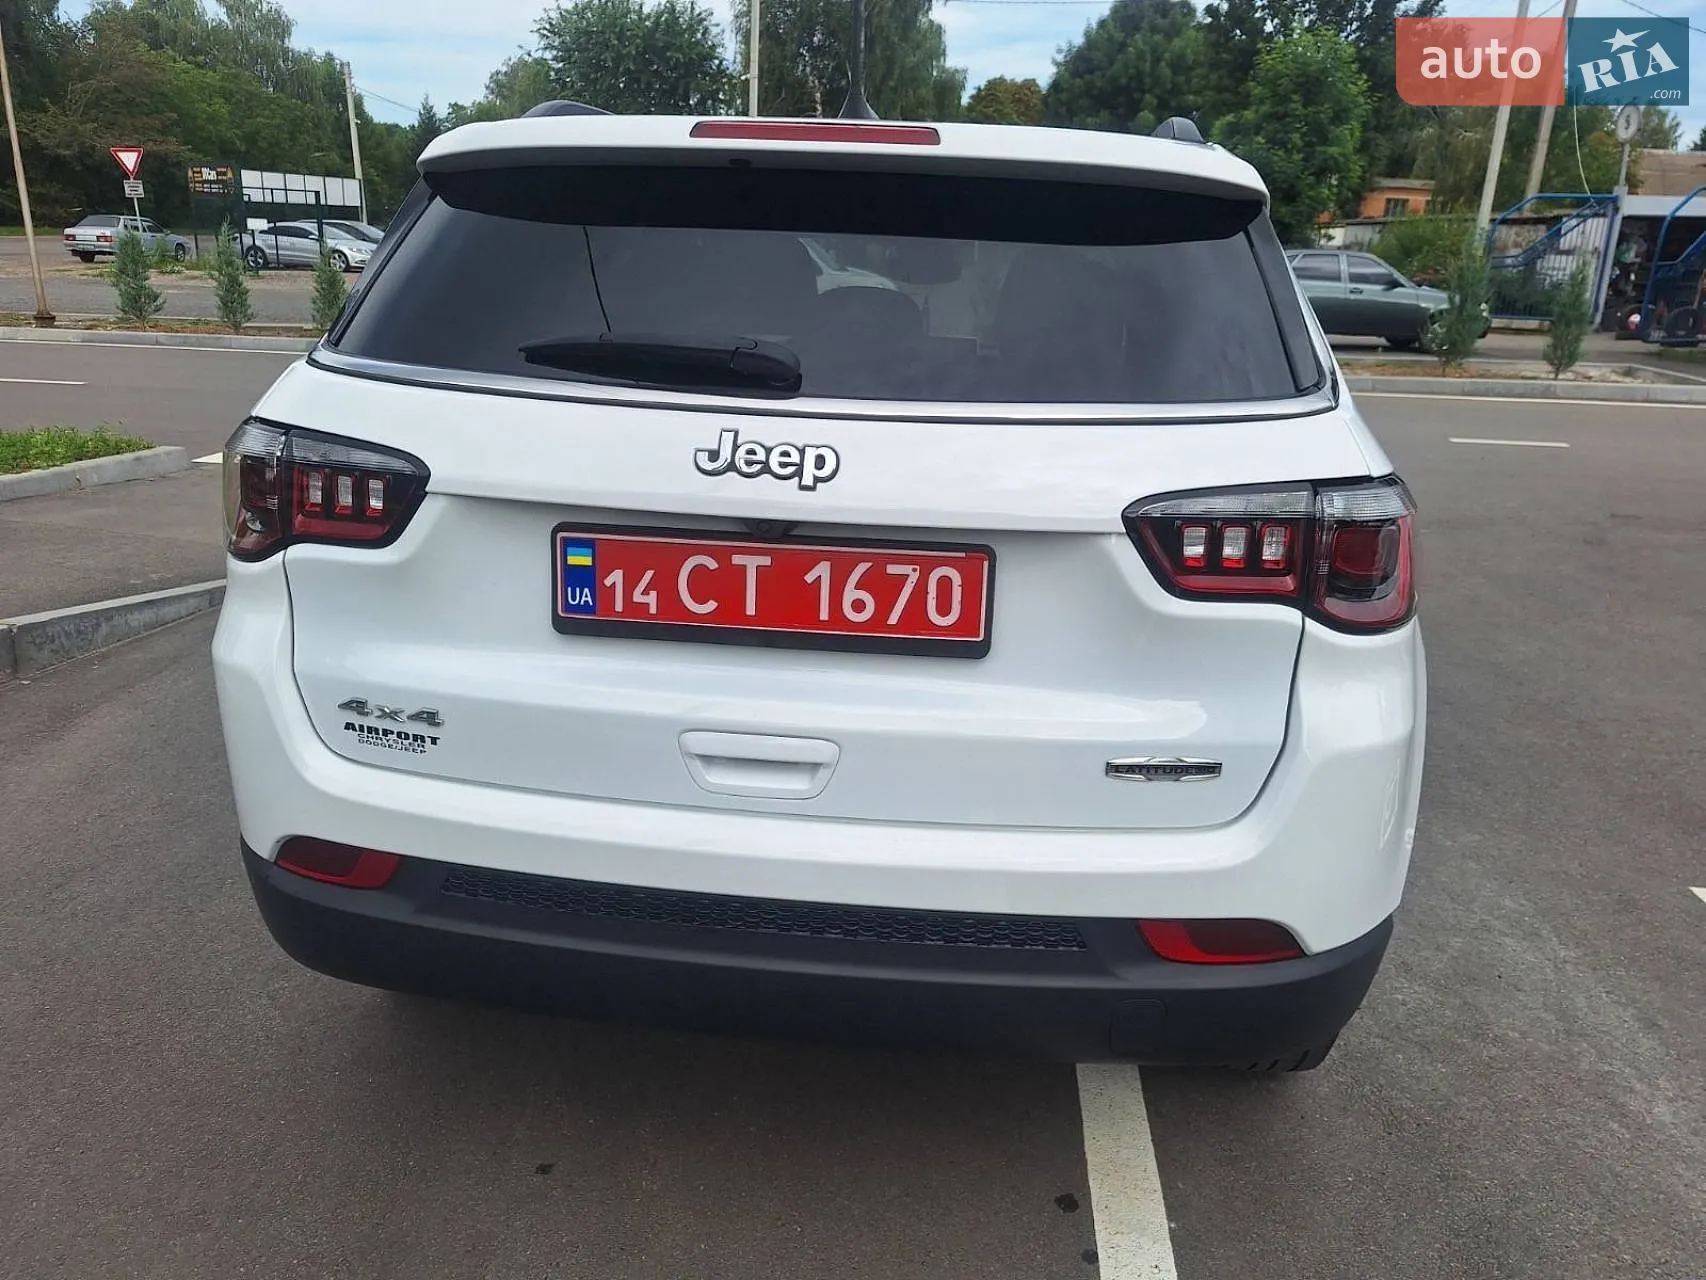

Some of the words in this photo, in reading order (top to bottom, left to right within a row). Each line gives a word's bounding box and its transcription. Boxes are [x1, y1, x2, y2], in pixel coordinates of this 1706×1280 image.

[694, 428, 840, 491] Jeep
[567, 587, 593, 606] UA
[603, 569, 657, 614] 14
[677, 554, 772, 616] CT
[803, 560, 962, 627] 1670
[343, 721, 441, 746] AIRPORT
[357, 733, 426, 749] CHRYSLER
